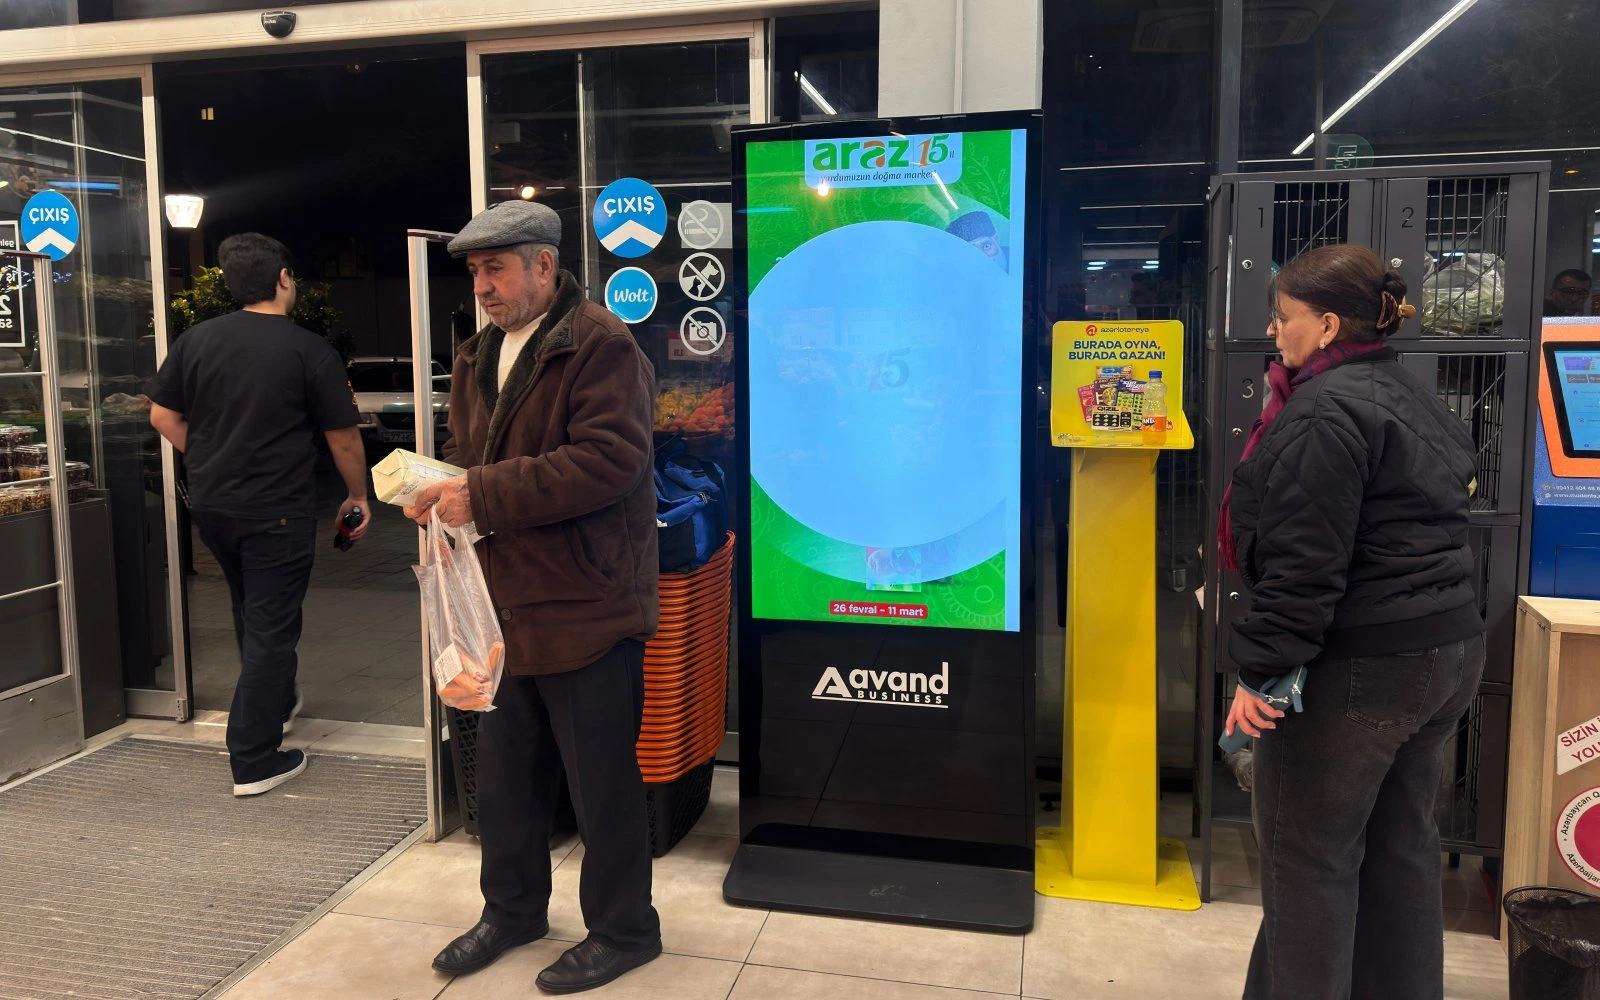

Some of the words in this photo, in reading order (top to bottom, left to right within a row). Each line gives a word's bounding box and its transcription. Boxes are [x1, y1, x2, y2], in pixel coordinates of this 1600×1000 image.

[812, 138, 911, 171] araz
[916, 133, 950, 168] 15
[872, 170, 902, 183] doğma
[29, 207, 70, 225] ÇIXIŞ
[604, 195, 655, 218] ÇIXIŞ
[1257, 207, 1264, 229] 1
[1401, 206, 1415, 229] 2
[614, 287, 649, 304] Wolt
[1074, 340, 1122, 350] BURADA
[1124, 340, 1161, 351] OYNA,
[1068, 351, 1117, 360] BURADA
[1119, 351, 1166, 360] QAZAN!
[1241, 378, 1255, 399] 3
[833, 603, 847, 612] 26
[849, 603, 877, 614] fevral
[887, 606, 897, 615] 11
[899, 607, 924, 616] mart
[849, 661, 949, 695] avand
[857, 690, 942, 704] BUSINESS
[1560, 722, 1599, 747] SİZİN
